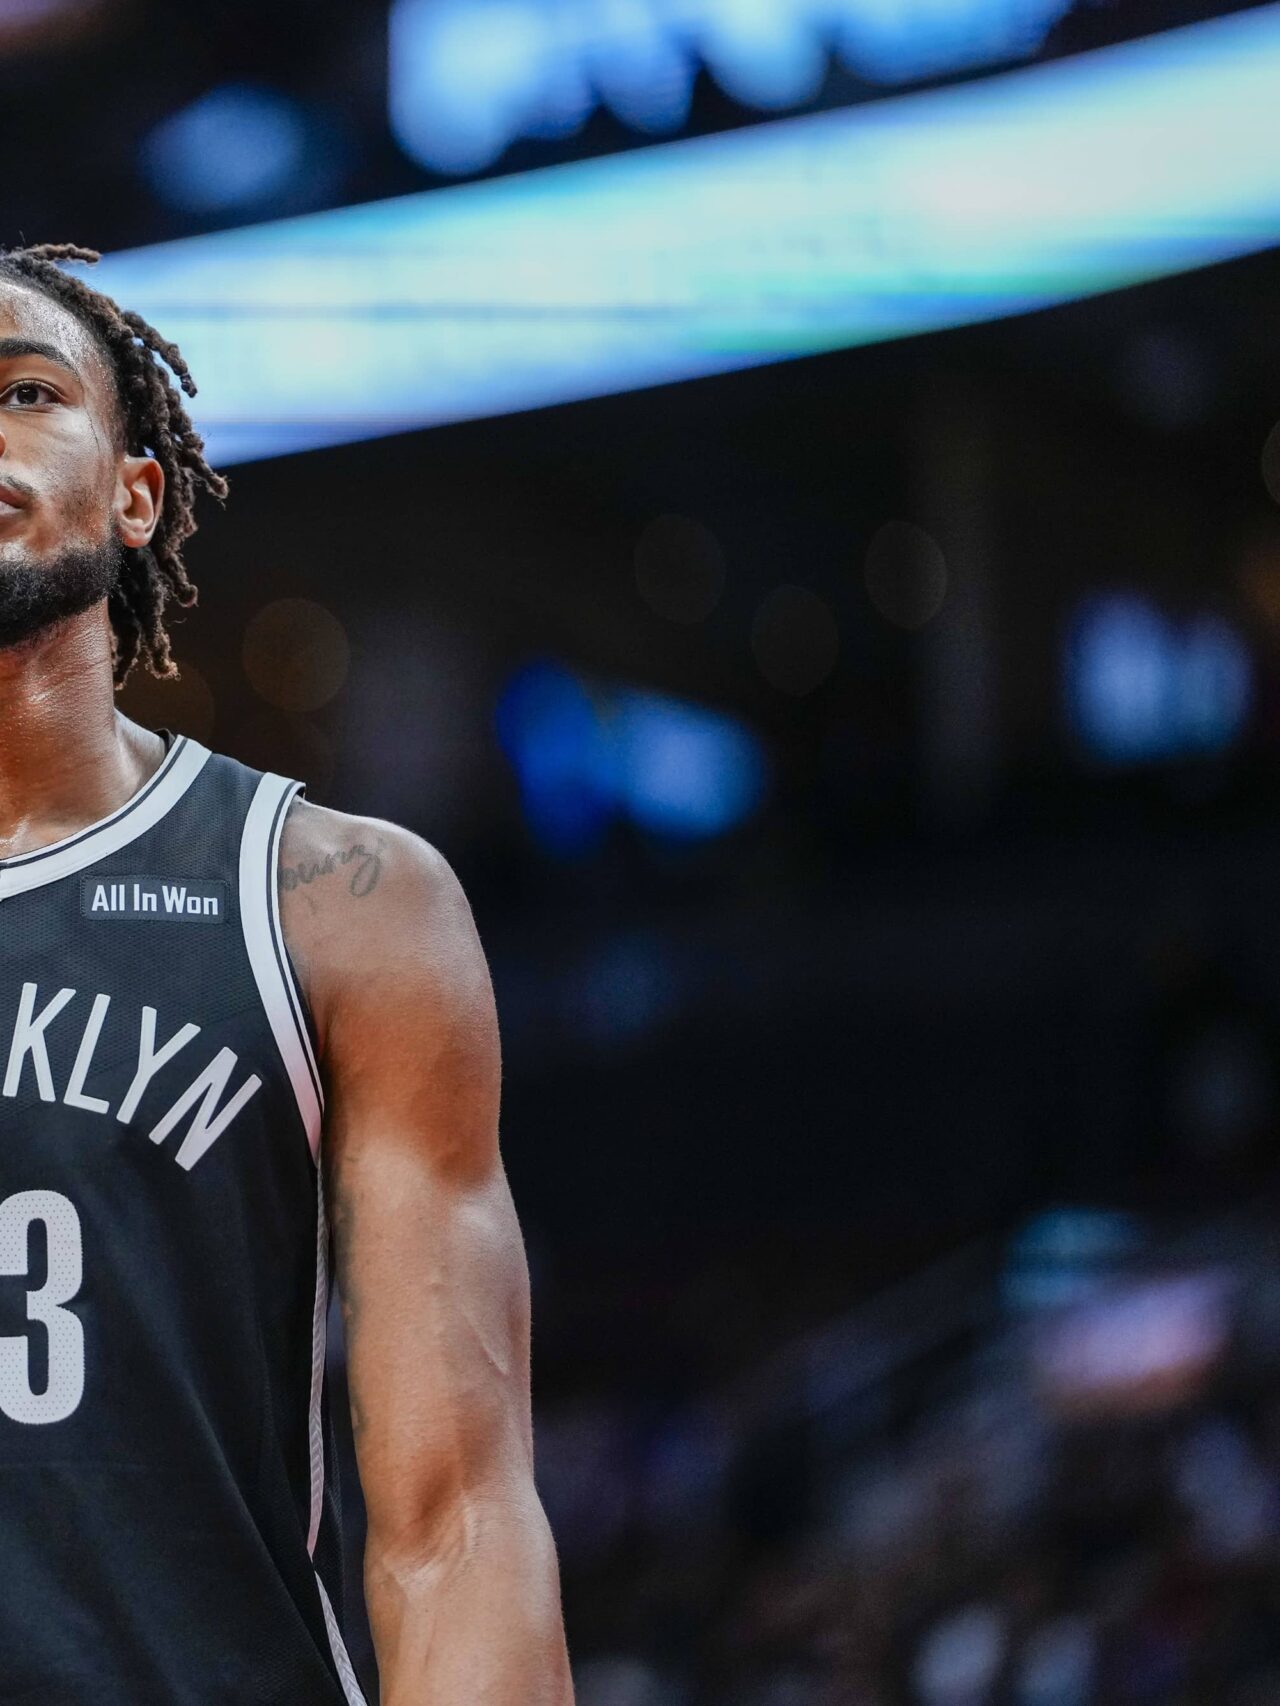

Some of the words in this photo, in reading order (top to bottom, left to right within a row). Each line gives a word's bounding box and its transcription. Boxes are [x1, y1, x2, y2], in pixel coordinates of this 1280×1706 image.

[91, 884, 126, 912] All
[133, 883, 158, 912] In
[161, 885, 219, 916] Won
